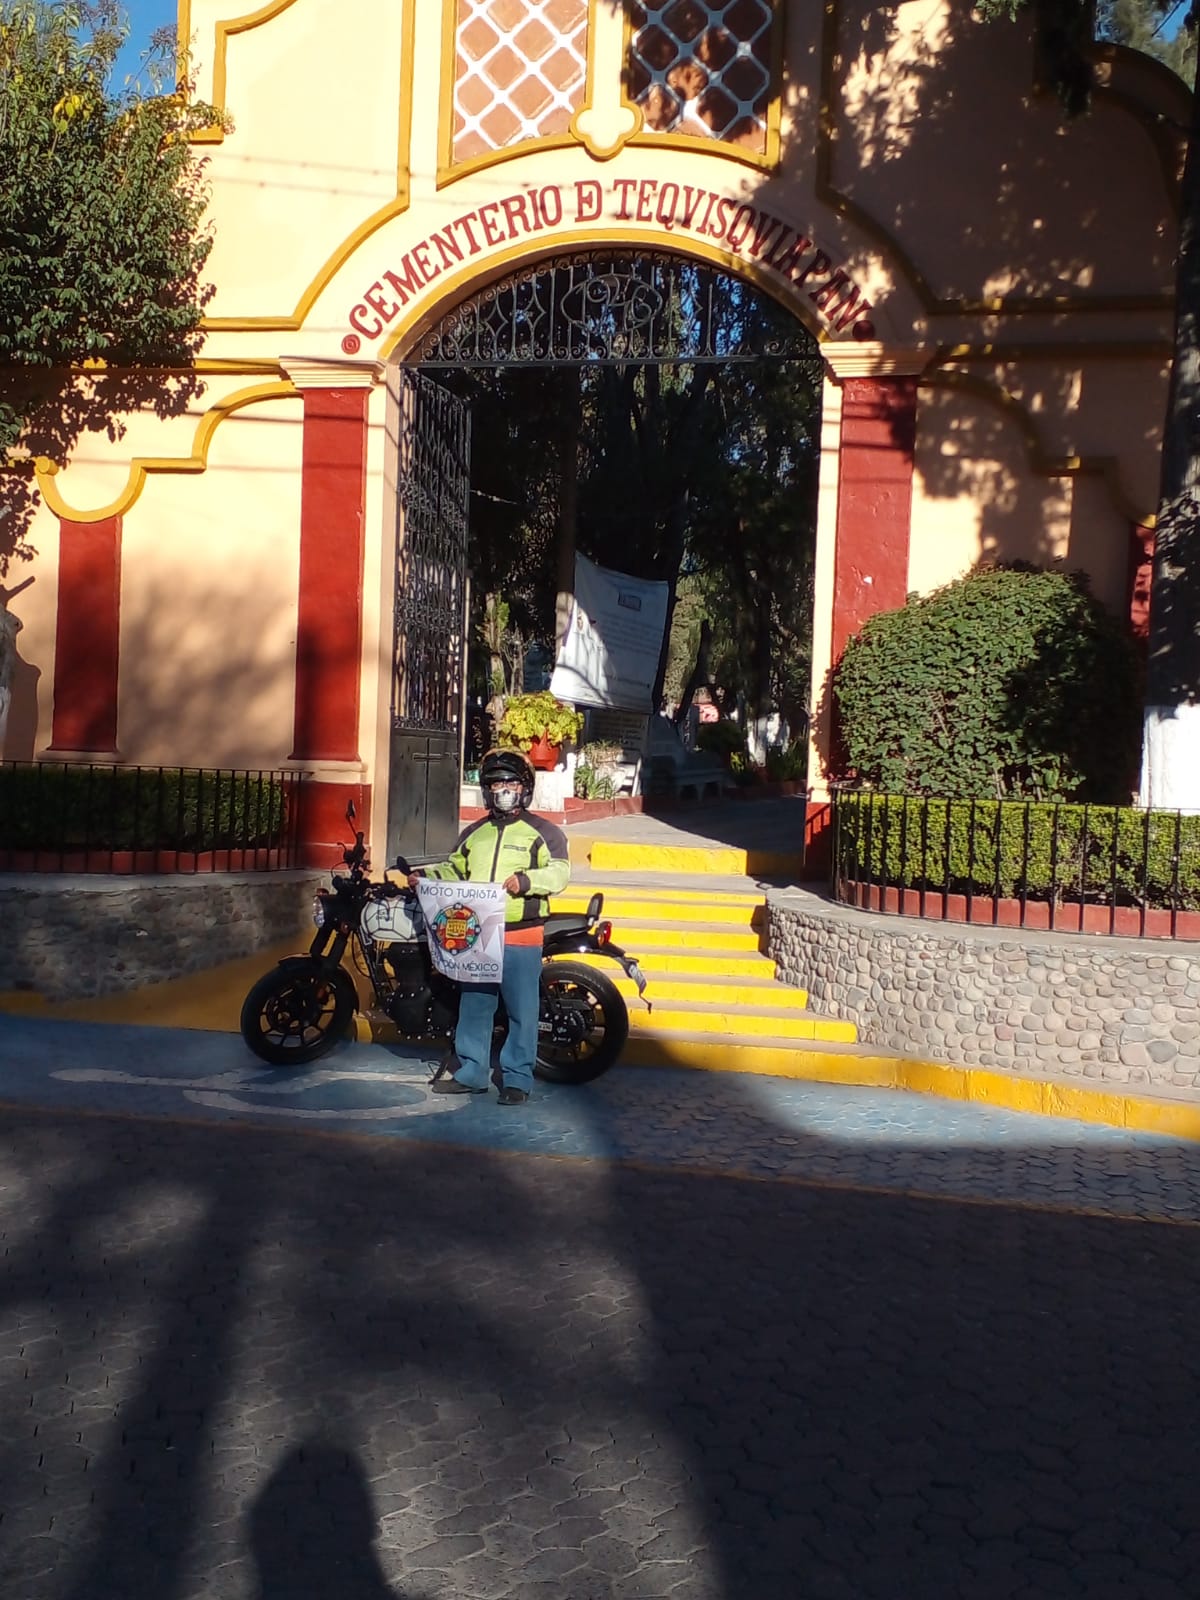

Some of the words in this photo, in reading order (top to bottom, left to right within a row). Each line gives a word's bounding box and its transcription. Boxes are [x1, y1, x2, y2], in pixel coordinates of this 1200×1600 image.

[349, 185, 562, 340] CEMENTERIO
[420, 886, 454, 897] MOTO
[457, 888, 498, 899] TURISTA
